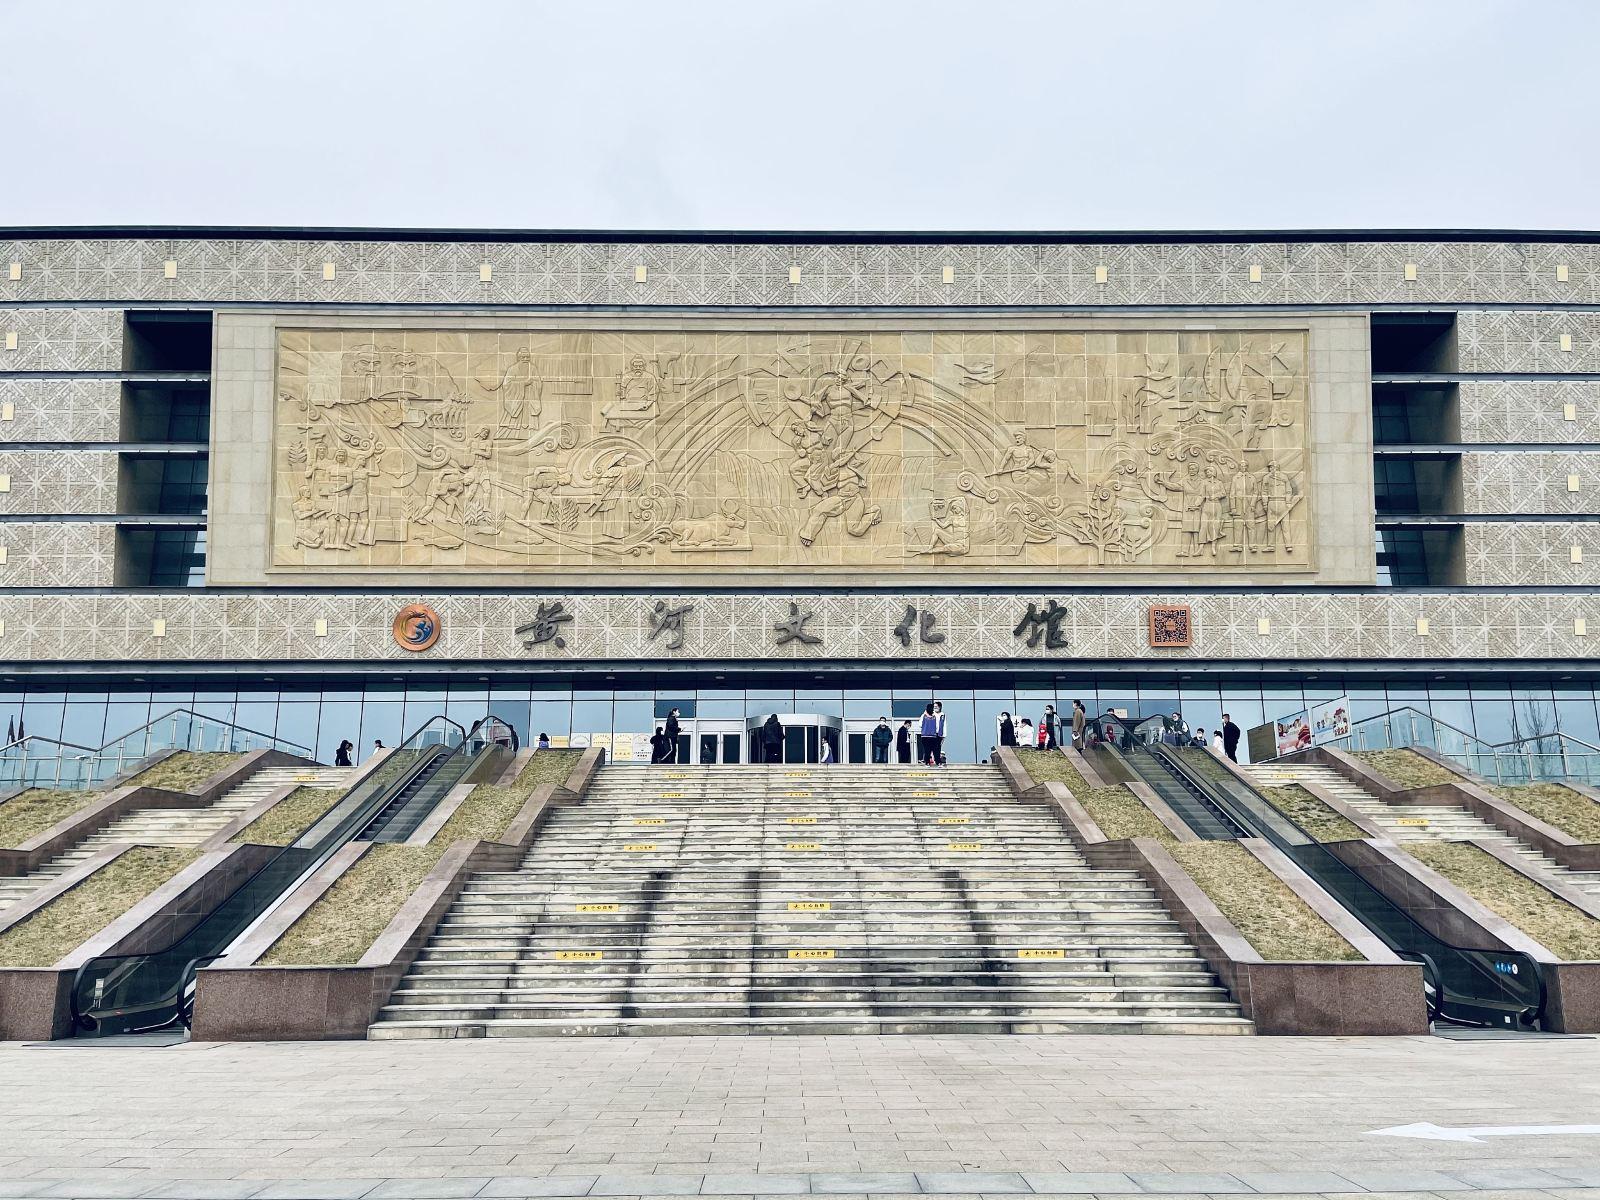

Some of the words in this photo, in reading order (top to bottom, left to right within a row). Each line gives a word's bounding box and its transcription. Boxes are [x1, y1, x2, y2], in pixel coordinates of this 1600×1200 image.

[515, 601, 1069, 650] 黄河文化馆
